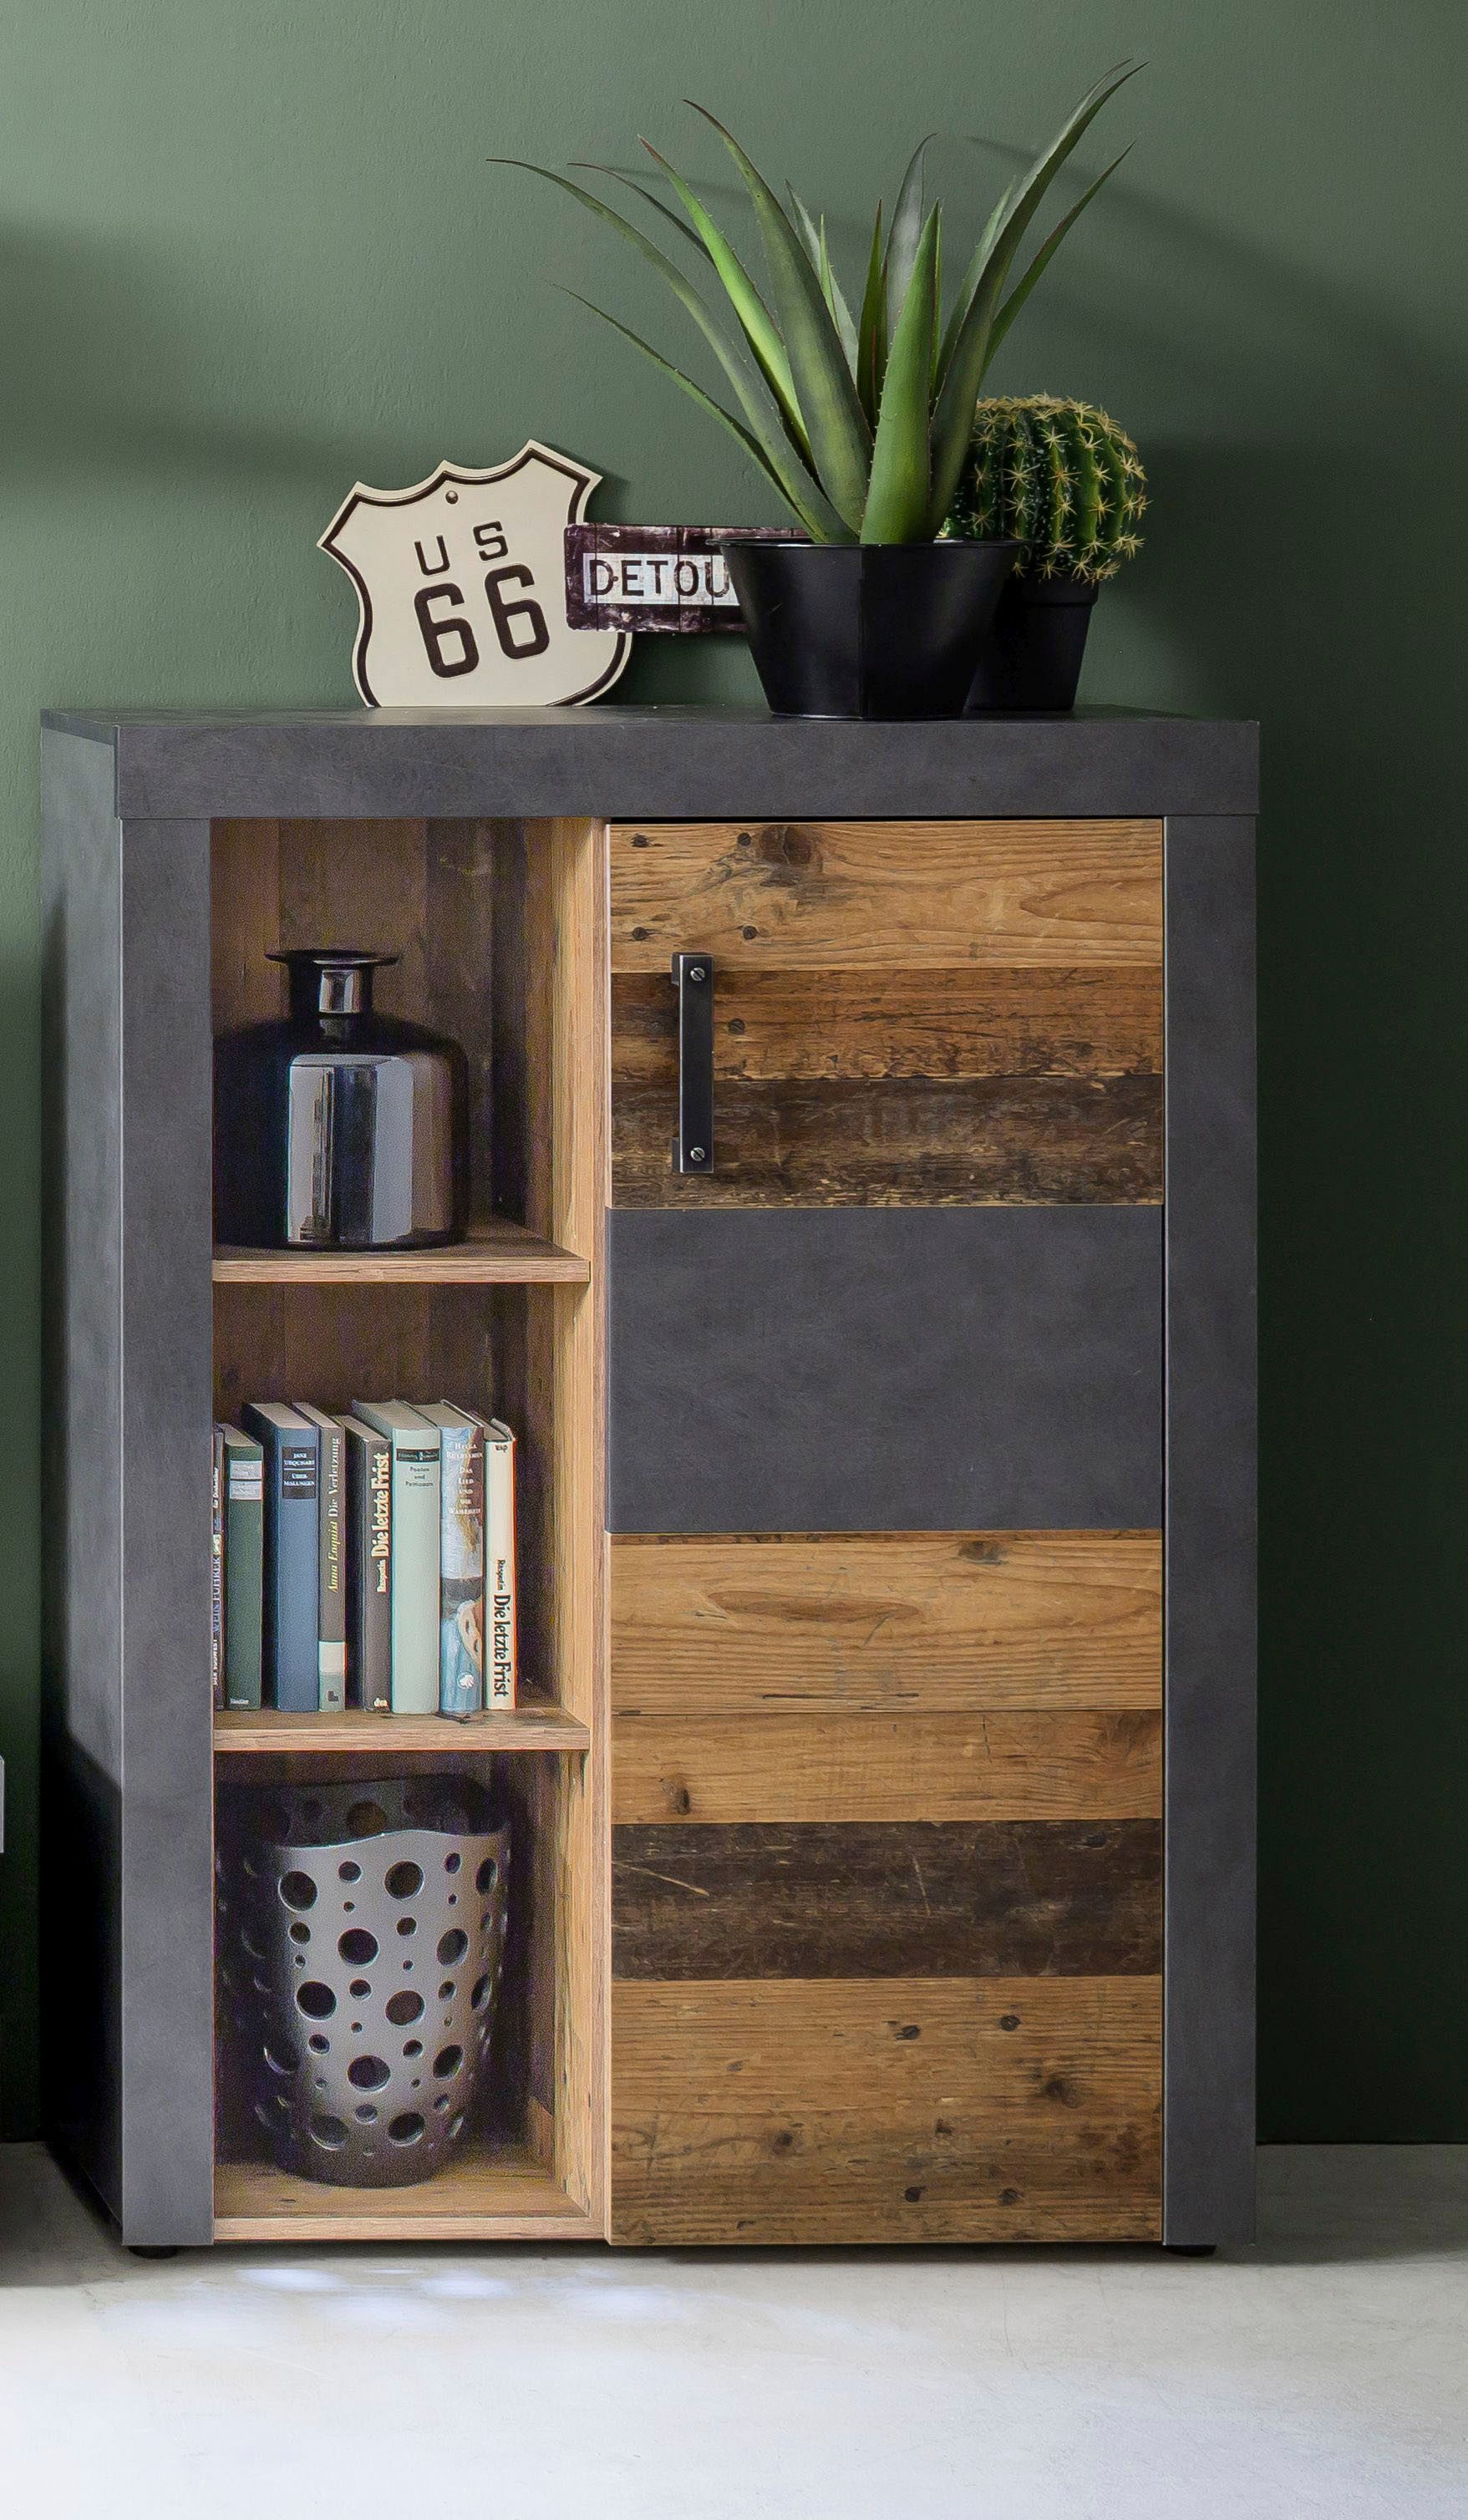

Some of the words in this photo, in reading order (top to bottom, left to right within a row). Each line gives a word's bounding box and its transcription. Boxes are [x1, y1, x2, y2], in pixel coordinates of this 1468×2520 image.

[414, 562, 551, 679] 66
[371, 1452, 389, 1489] Frist
[327, 1498, 339, 1517] Die
[371, 1491, 389, 1531] letzte
[371, 1532, 389, 1557] Die
[494, 1594, 511, 1618] Die
[494, 1621, 511, 1659] letzte
[494, 1662, 511, 1697] Frist
